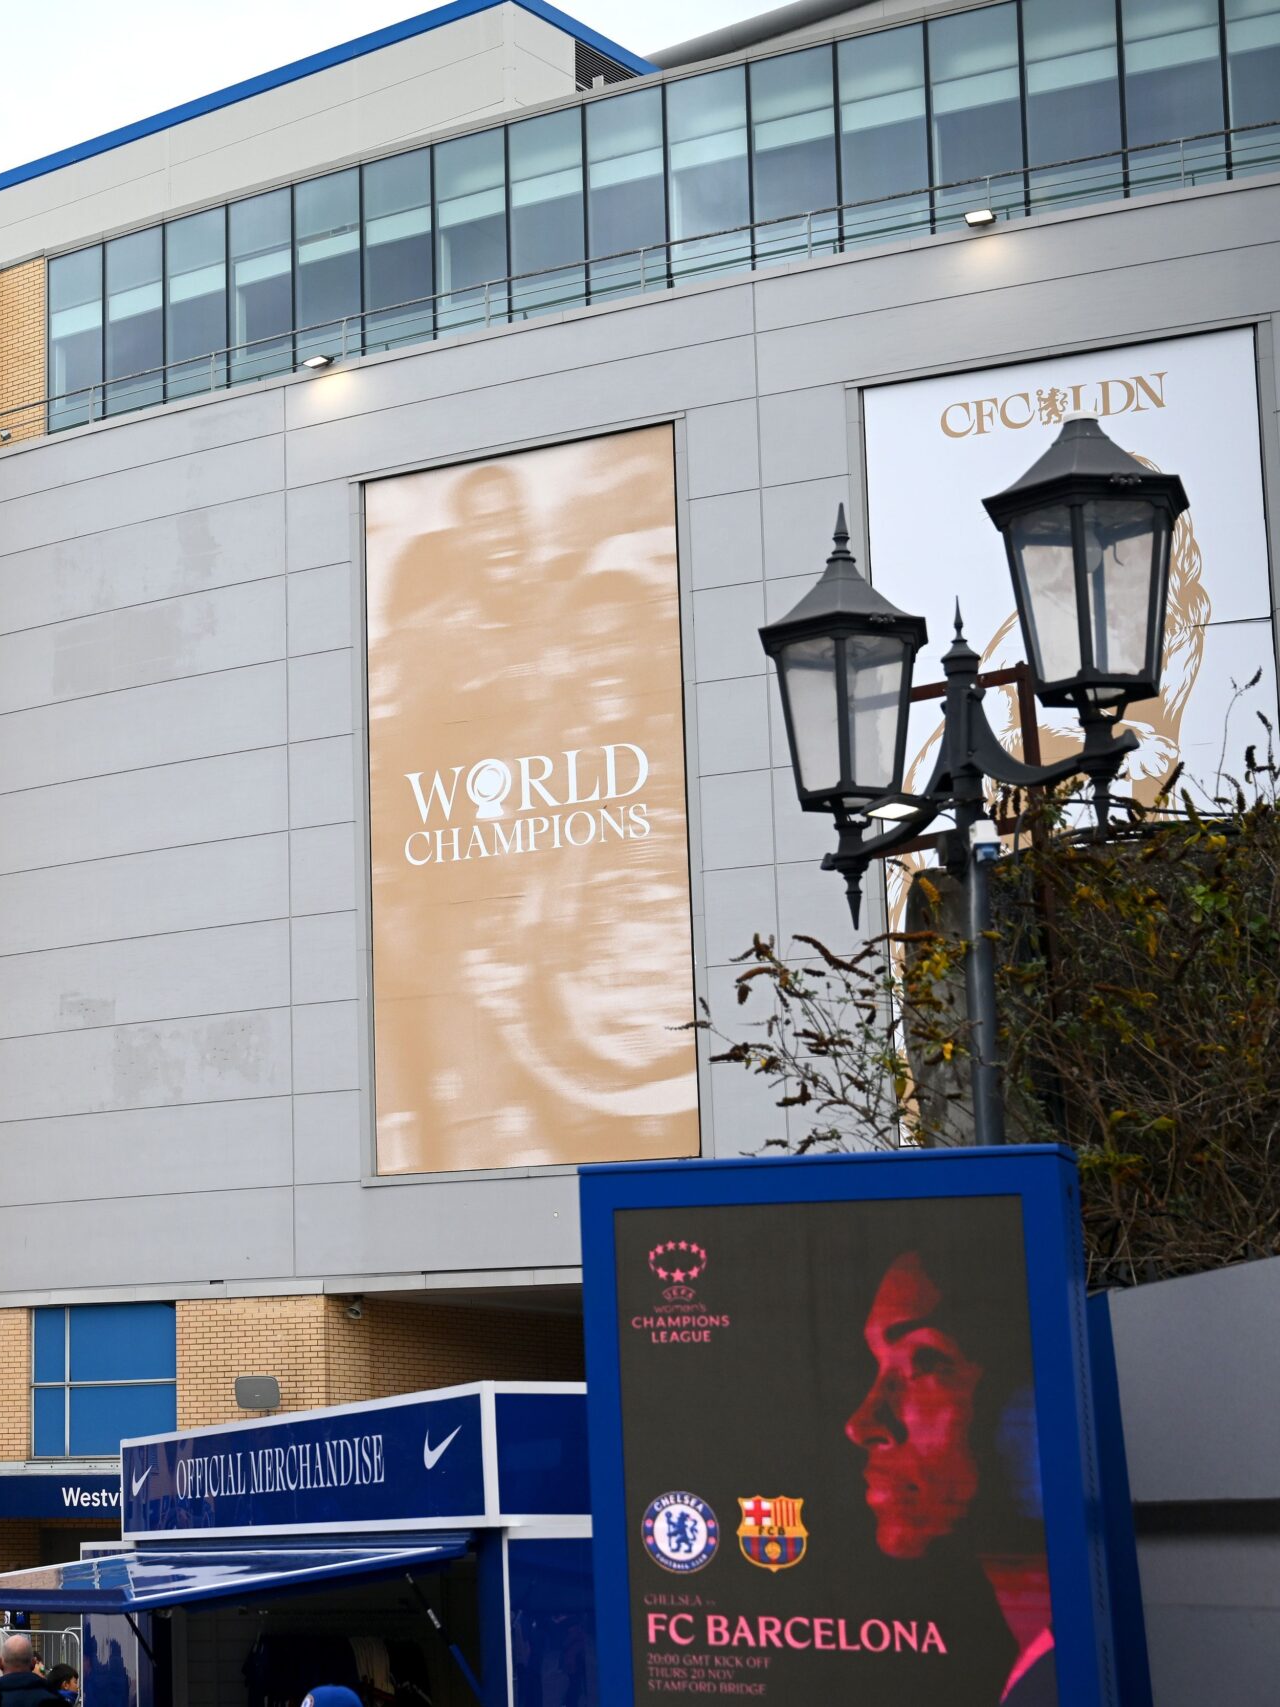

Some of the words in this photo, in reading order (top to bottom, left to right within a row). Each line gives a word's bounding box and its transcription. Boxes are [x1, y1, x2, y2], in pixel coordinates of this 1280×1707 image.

[940, 392, 1035, 438] CFC
[404, 743, 649, 825] WORLD
[404, 803, 651, 866] CHAMPIONS
[663, 1286, 695, 1301] UEFA
[631, 1314, 731, 1329] CHAMPIONS
[651, 1330, 712, 1344] LEAGUE
[175, 1452, 247, 1500] OFFICIAL
[249, 1434, 385, 1495] MERCHANDISE
[61, 1486, 121, 1507] Westvi
[653, 1494, 704, 1512] CHELSEA
[643, 1593, 703, 1606] CHELSEA
[647, 1613, 695, 1645] FC
[706, 1614, 948, 1654] BARCELONA
[646, 1653, 680, 1666] 20:00
[682, 1654, 711, 1667] GMT
[714, 1655, 744, 1668] KICK
[746, 1656, 771, 1669] OFF
[647, 1667, 688, 1679] THURS
[691, 1668, 706, 1679] 20
[707, 1669, 736, 1681] NOV
[647, 1679, 717, 1693] STAMFORD
[719, 1681, 767, 1695] BRIDGE
